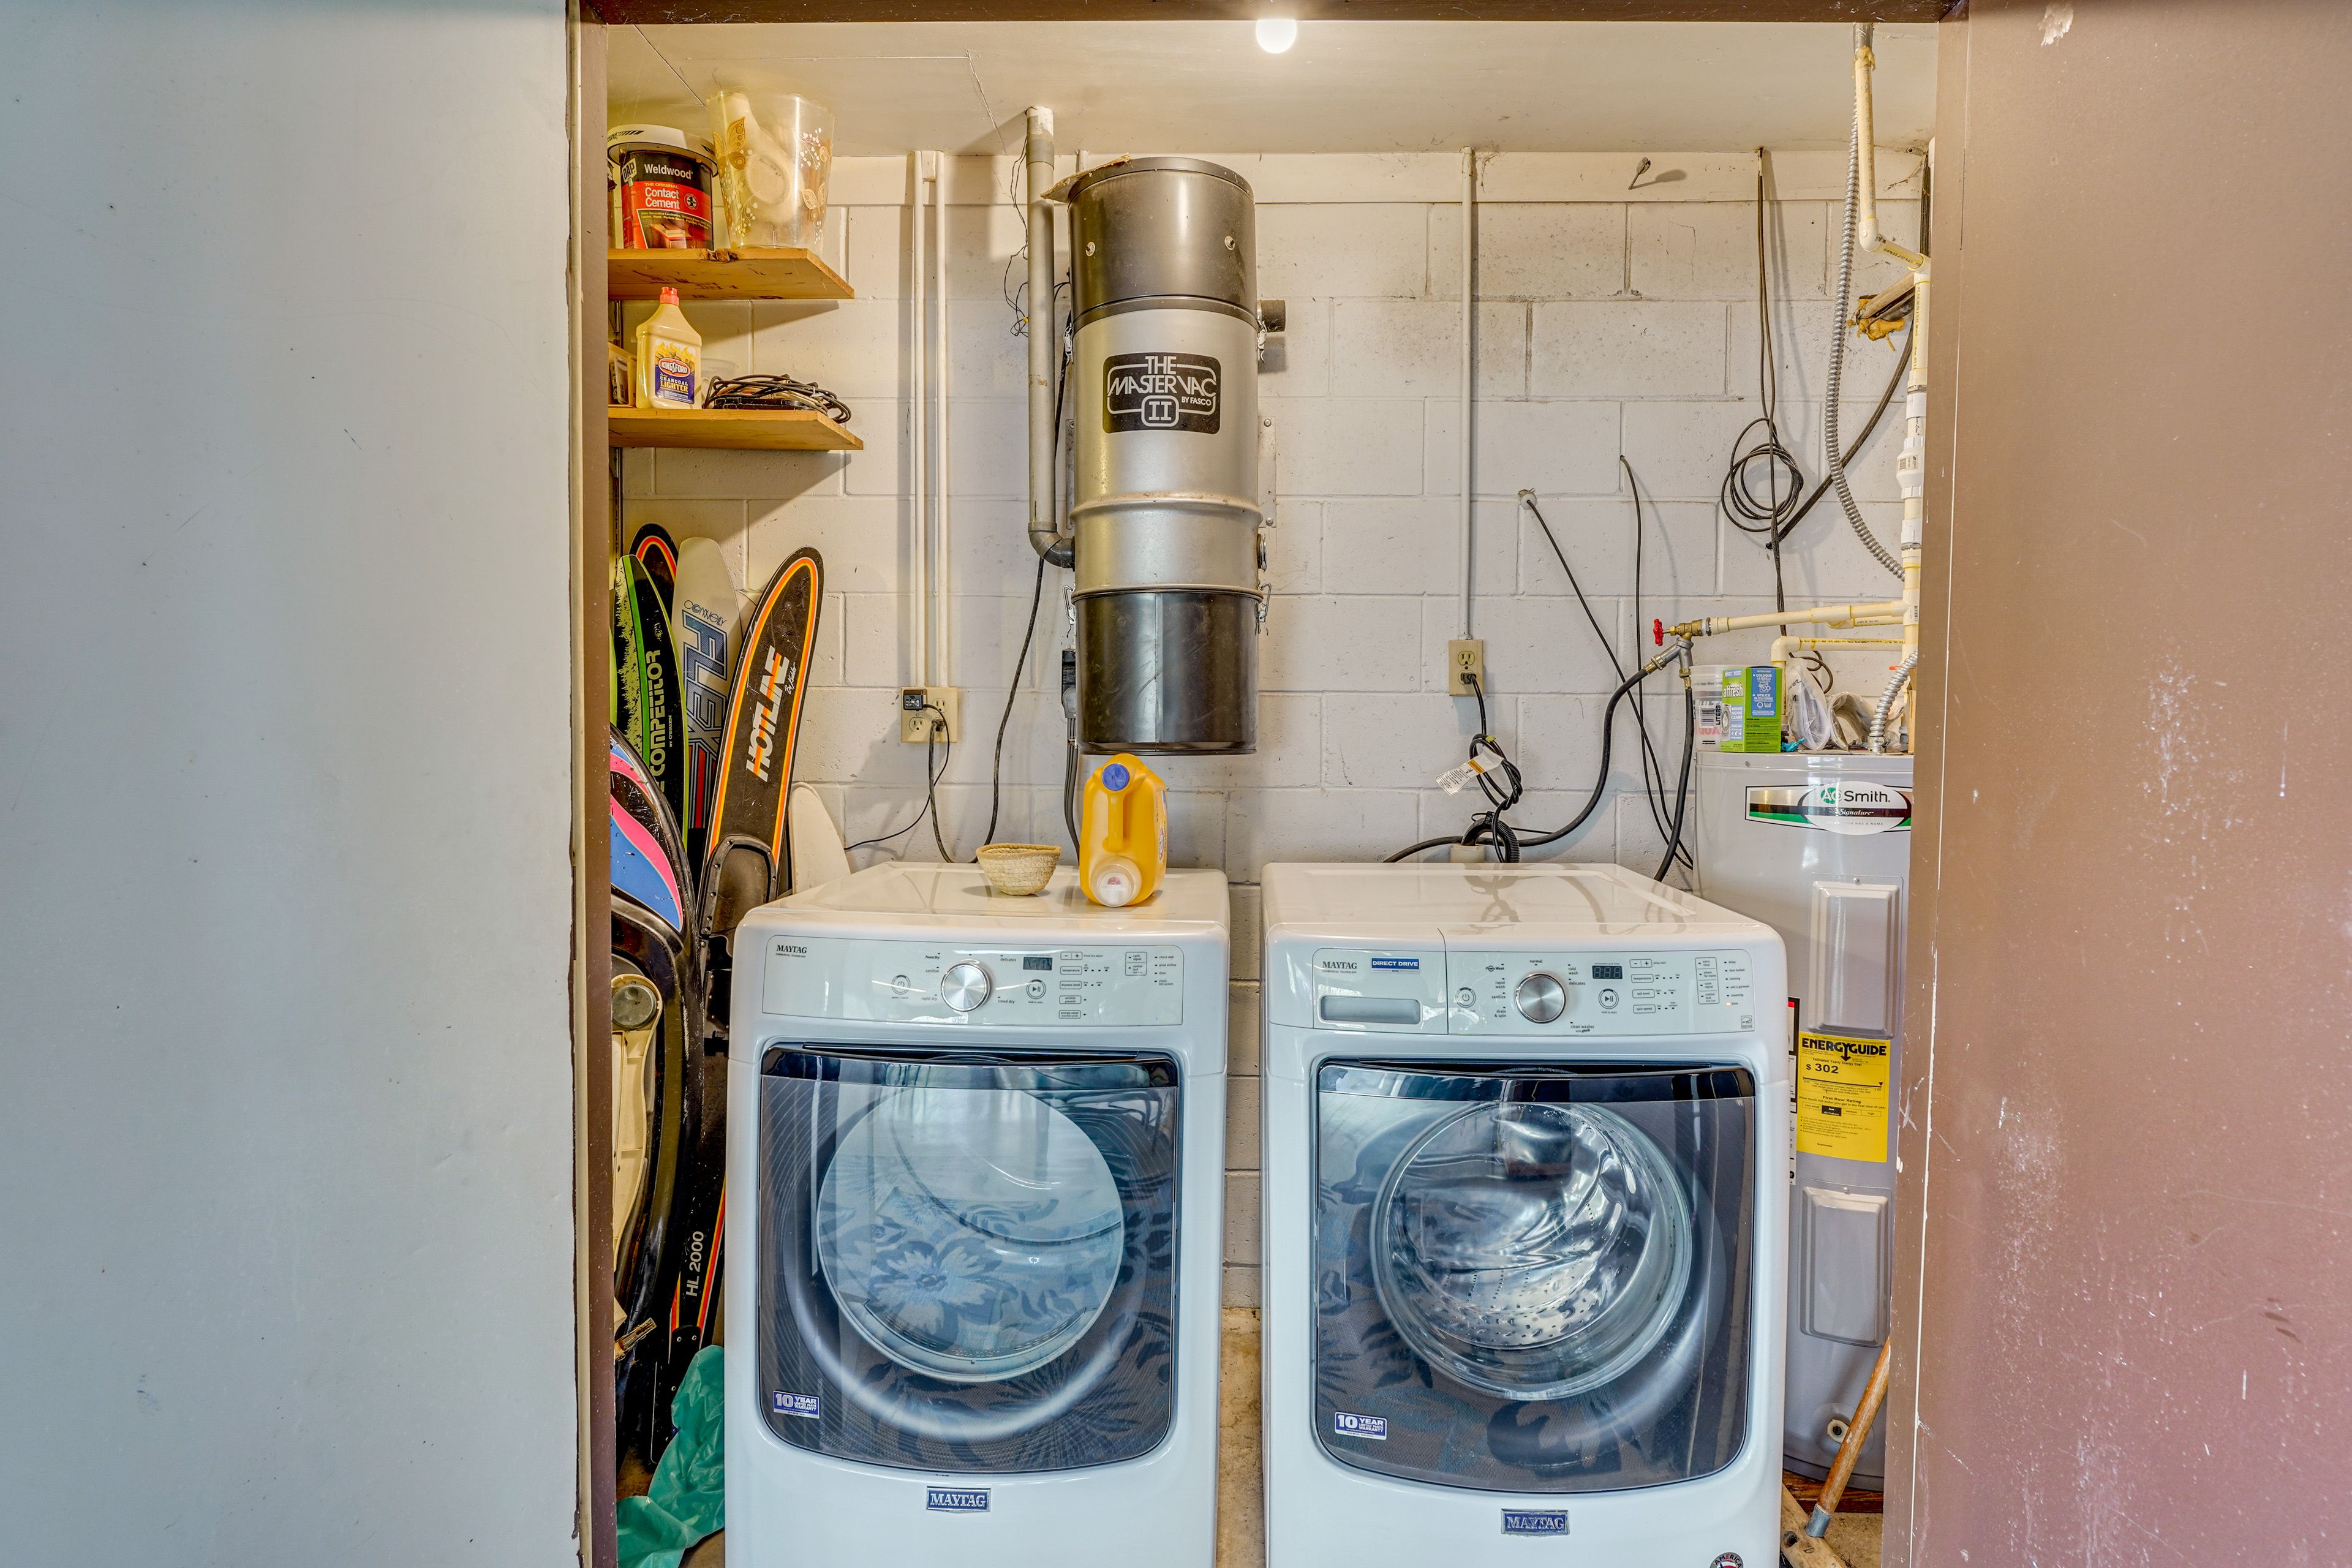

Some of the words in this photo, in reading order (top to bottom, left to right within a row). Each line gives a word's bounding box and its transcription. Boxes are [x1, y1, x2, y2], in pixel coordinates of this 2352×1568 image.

[644, 164, 692, 179] Weldwood
[645, 187, 679, 200] Contact
[646, 197, 680, 209] Cement
[662, 361, 687, 373] KINGSFORD
[1145, 356, 1177, 375] THE
[660, 375, 688, 386] CHARCOAL
[660, 380, 688, 392] LIGHTER
[1190, 397, 1211, 406] FASCO
[1148, 401, 1172, 420] II
[1723, 683, 1743, 698] affresh
[646, 650, 666, 776] COMPETITOR
[746, 645, 790, 782] HOTLINE
[777, 944, 807, 954] MAYTAG
[1815, 1063, 1839, 1074] 302
[689, 1231, 704, 1273] 2000
[685, 1276, 699, 1297] HL
[775, 1393, 794, 1408] 10
[1338, 1414, 1358, 1428] 10
[1359, 1417, 1384, 1426] YEAR
[930, 1493, 986, 1507] MAYTAG
[1507, 1516, 1564, 1529] MAYTAG
[1715, 1554, 1742, 1568] AMERICA
